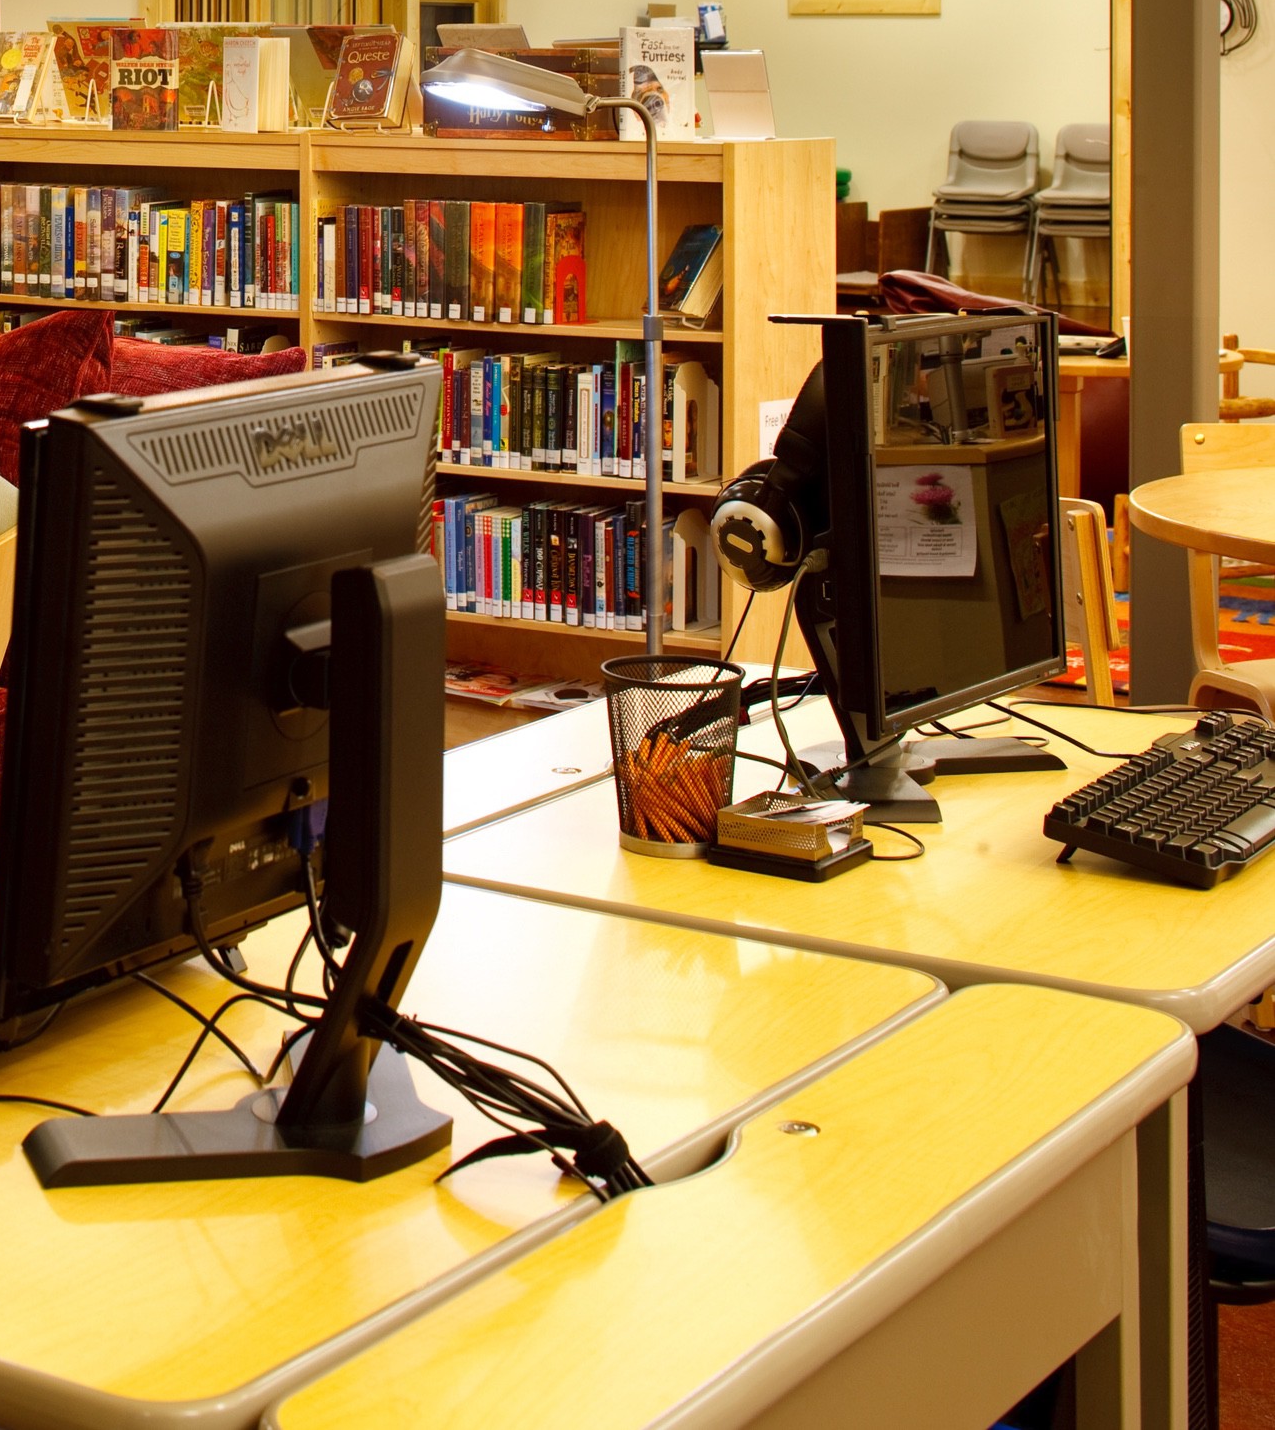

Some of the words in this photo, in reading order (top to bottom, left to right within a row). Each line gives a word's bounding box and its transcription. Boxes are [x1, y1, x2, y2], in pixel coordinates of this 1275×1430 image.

[640, 39, 663, 50] Fast
[347, 50, 390, 64] Queste
[640, 51, 685, 63] Furriest
[118, 68, 173, 85] RIOT
[765, 414, 779, 427] Free
[535, 547, 543, 561] 100
[627, 537, 635, 564] ALFRED
[626, 567, 635, 591] KROPP
